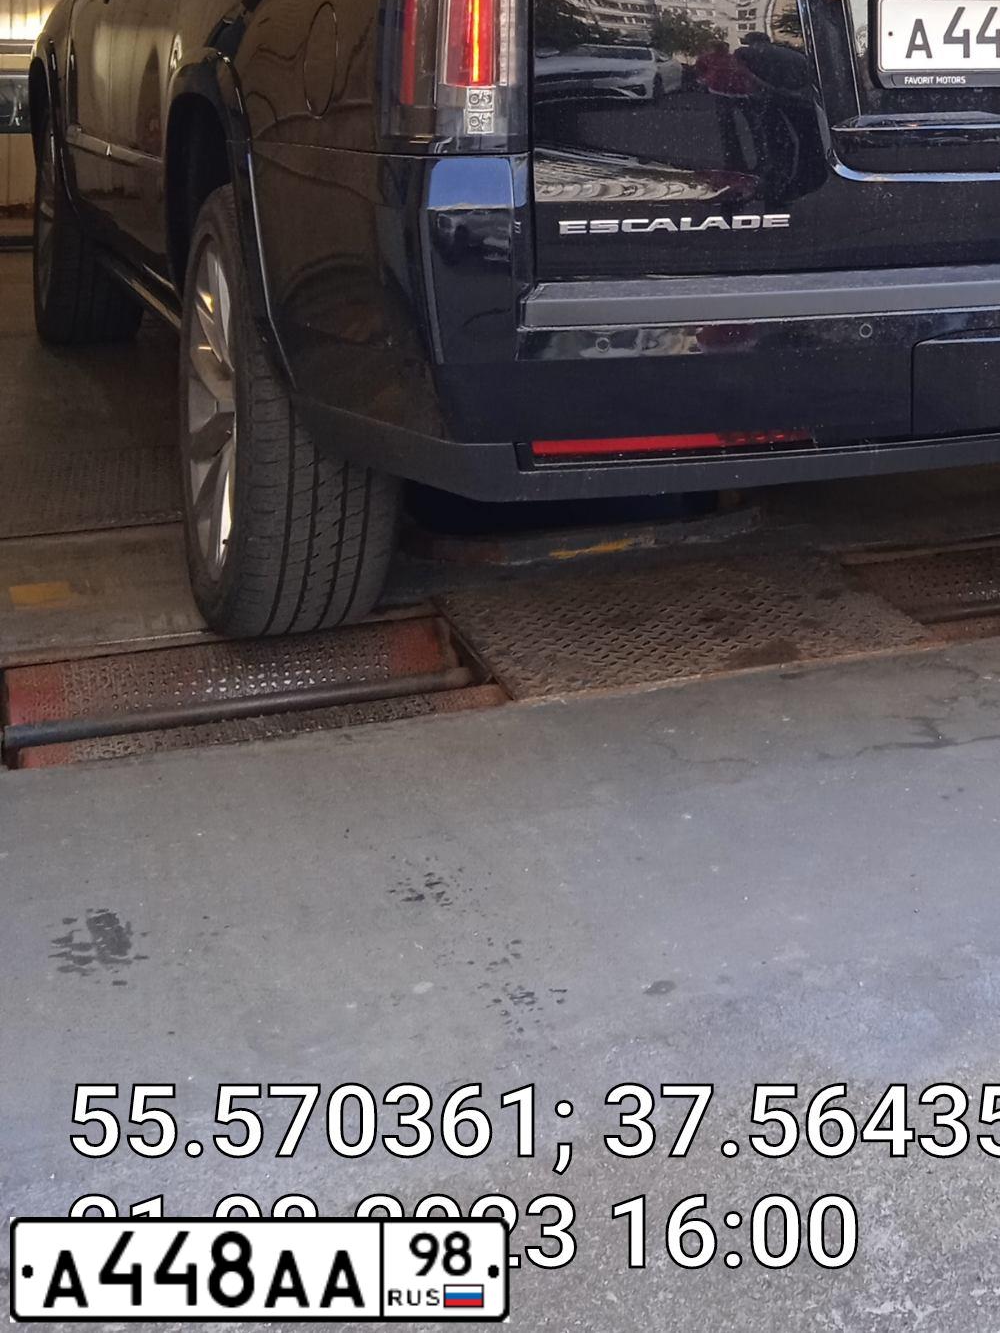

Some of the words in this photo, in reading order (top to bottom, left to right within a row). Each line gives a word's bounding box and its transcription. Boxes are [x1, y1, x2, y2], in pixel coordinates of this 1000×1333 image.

[904, 75, 934, 85] FAVORIT
[936, 75, 967, 85] MOTORS
[558, 214, 791, 235] ESCALADE
